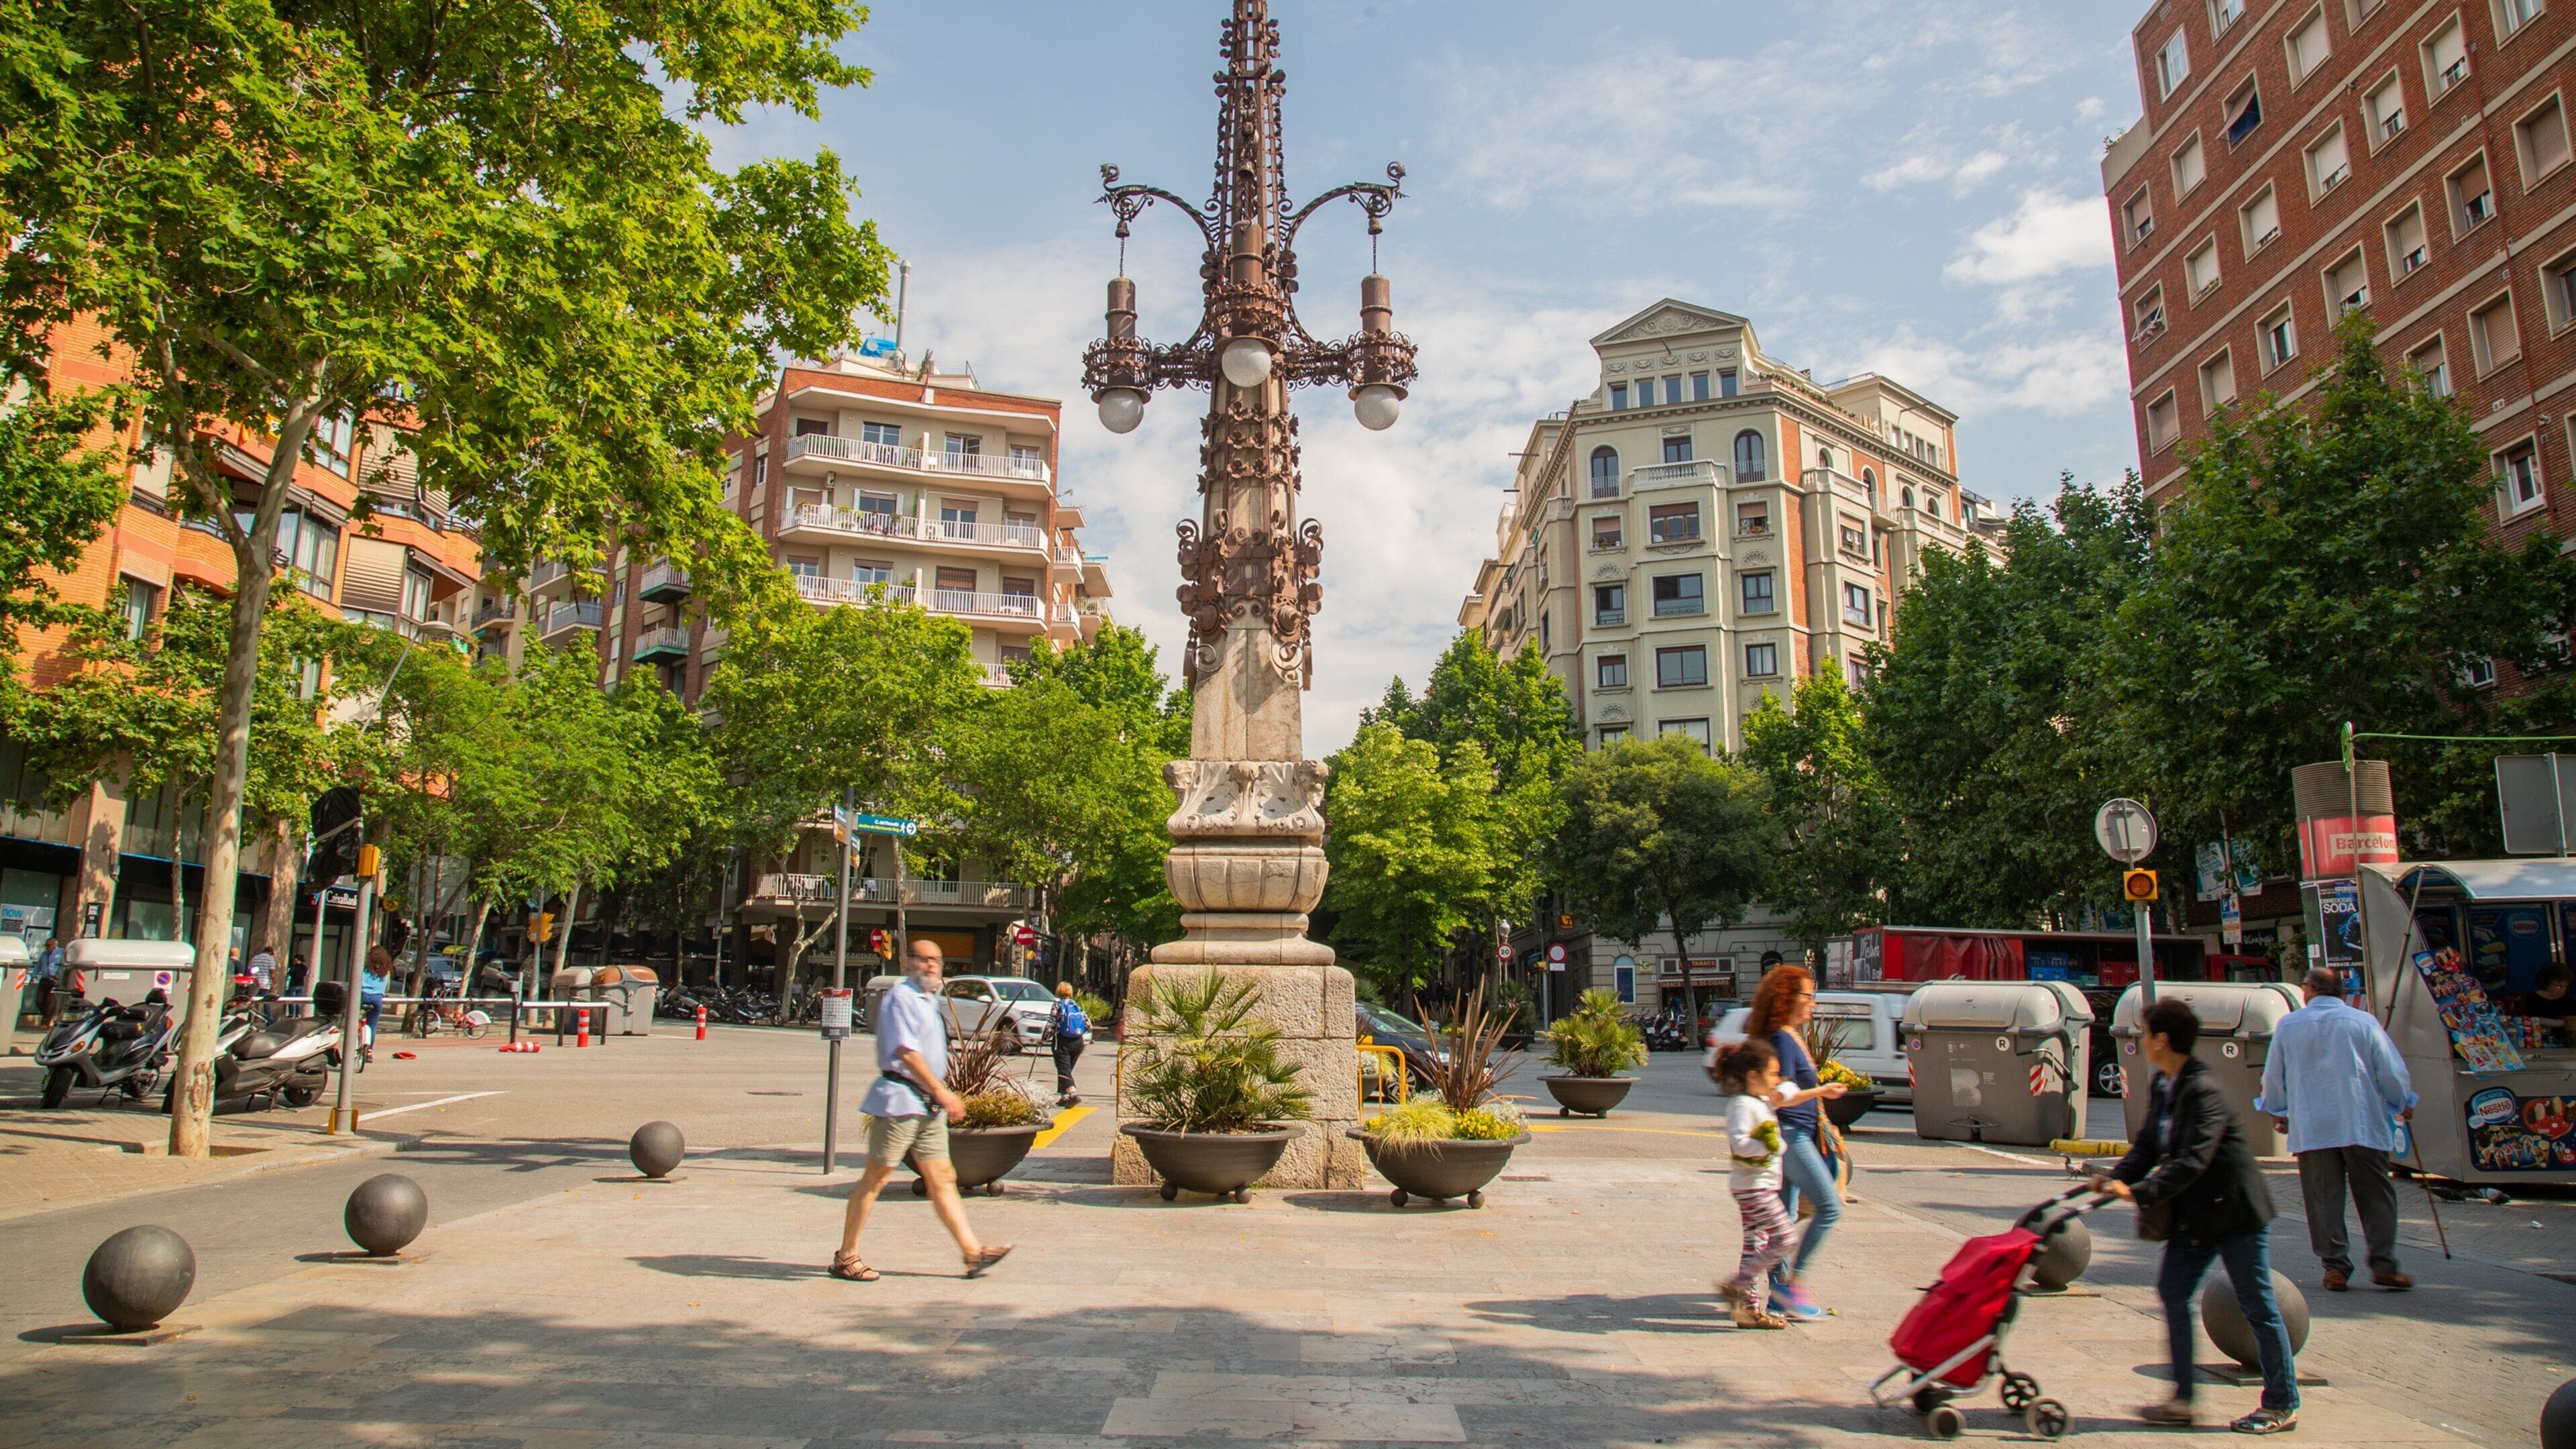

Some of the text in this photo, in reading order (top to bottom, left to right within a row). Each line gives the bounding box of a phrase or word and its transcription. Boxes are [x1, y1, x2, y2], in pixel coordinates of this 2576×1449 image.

[327, 890, 358, 906] CaixaBank
[3, 908, 23, 918] now
[2323, 902, 2357, 914] SODA
[829, 950, 877, 958] Pzzenza
[1999, 1040, 2006, 1049] R
[2226, 1045, 2234, 1055] R
[2479, 1099, 2512, 1116] Nestlé
